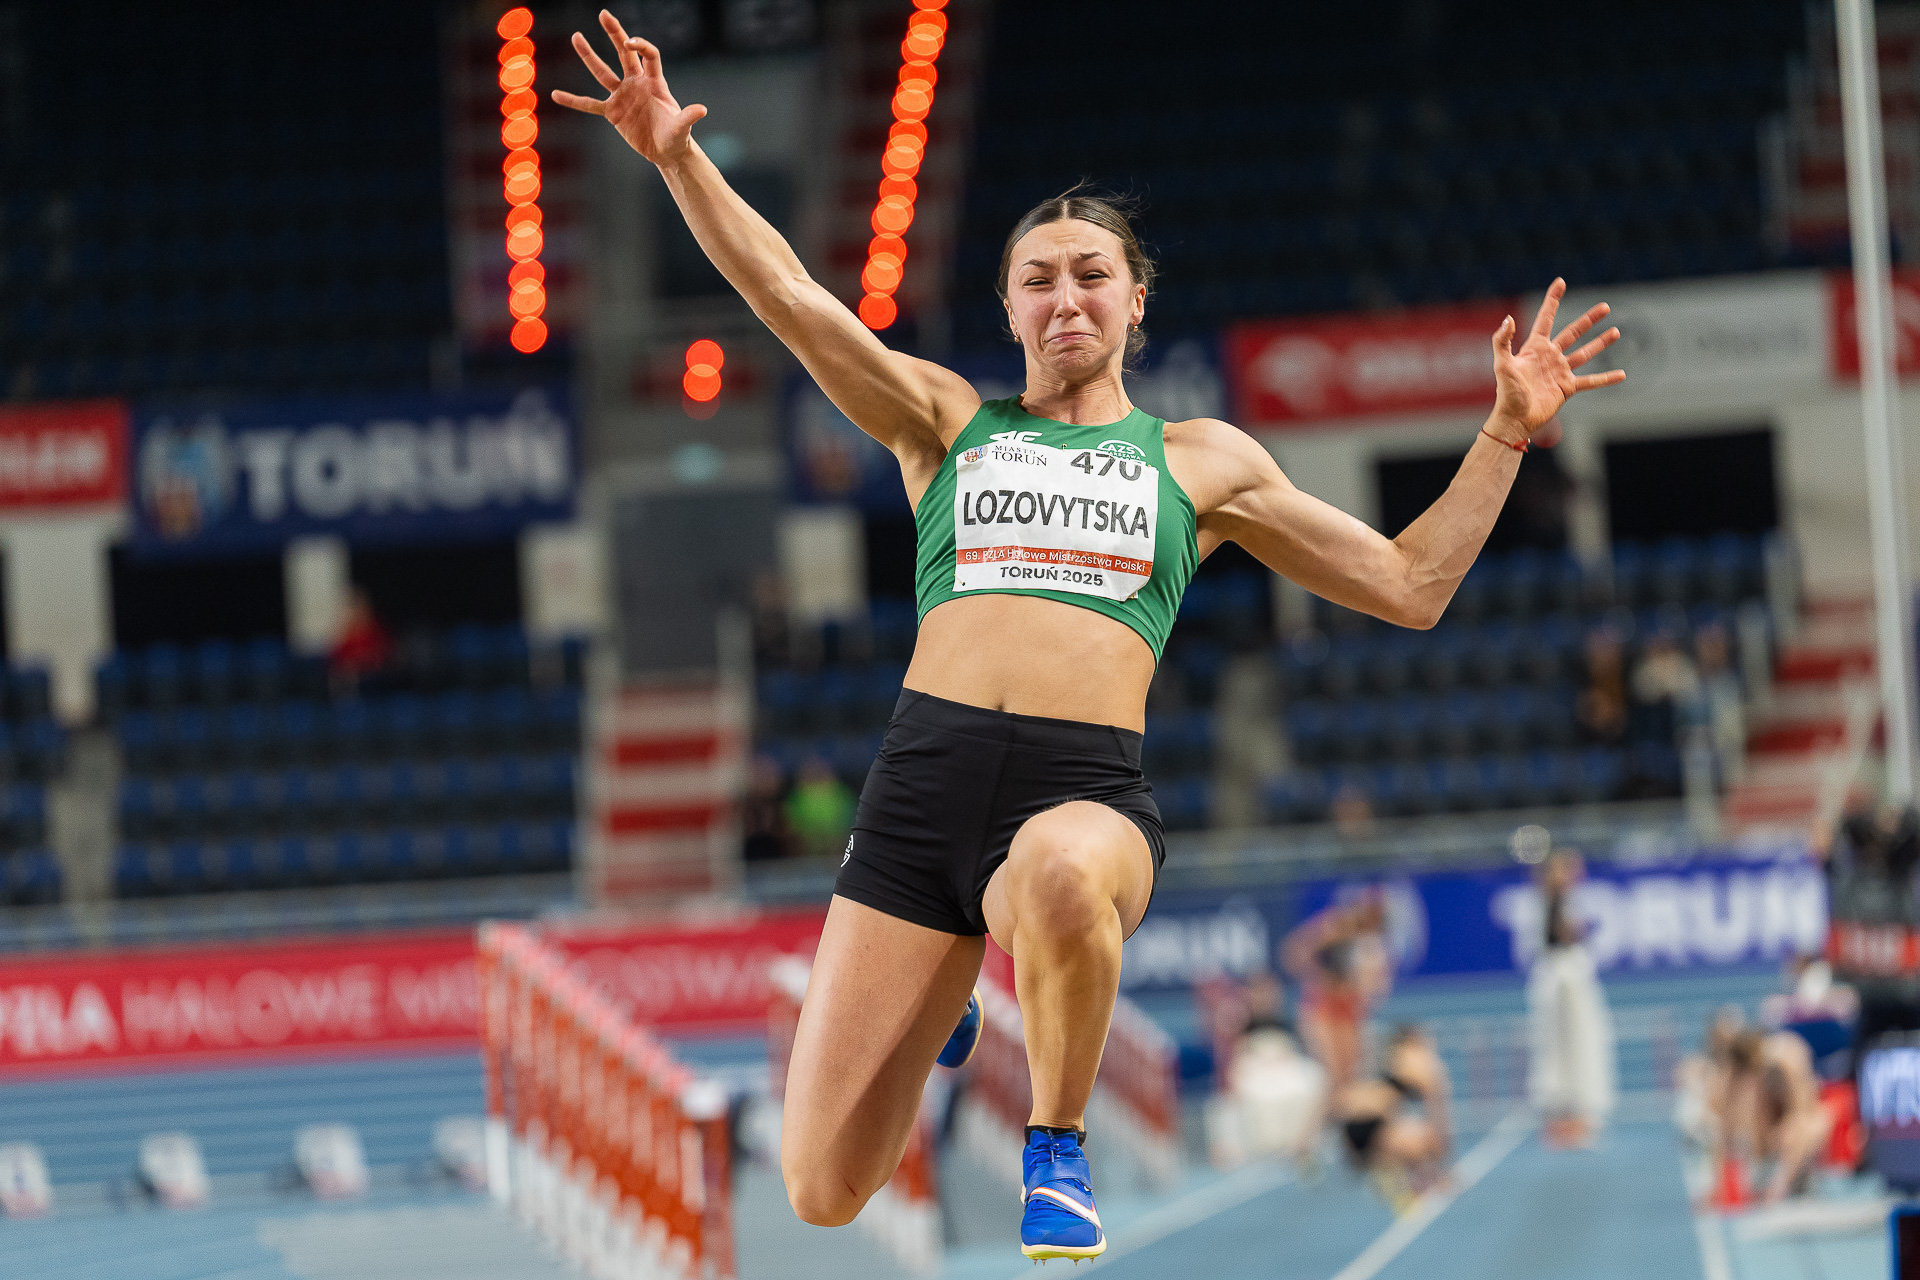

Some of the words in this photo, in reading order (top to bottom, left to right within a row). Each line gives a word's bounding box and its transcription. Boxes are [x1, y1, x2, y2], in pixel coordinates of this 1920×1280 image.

[240, 392, 572, 520] TORUŃ
[991, 450, 1047, 466] TORUŃ
[994, 445, 1036, 455] MIASTO
[1107, 443, 1136, 455] AZS
[1070, 451, 1142, 481] 470
[963, 489, 1150, 539] LOZOVYTSKA
[965, 550, 981, 561] 69.
[983, 548, 1005, 560] PZLA
[1048, 551, 1112, 567] Mistrzostwa
[1114, 560, 1146, 573] Polski
[1000, 566, 1058, 581] TORUŃ
[1062, 569, 1104, 587] 2025
